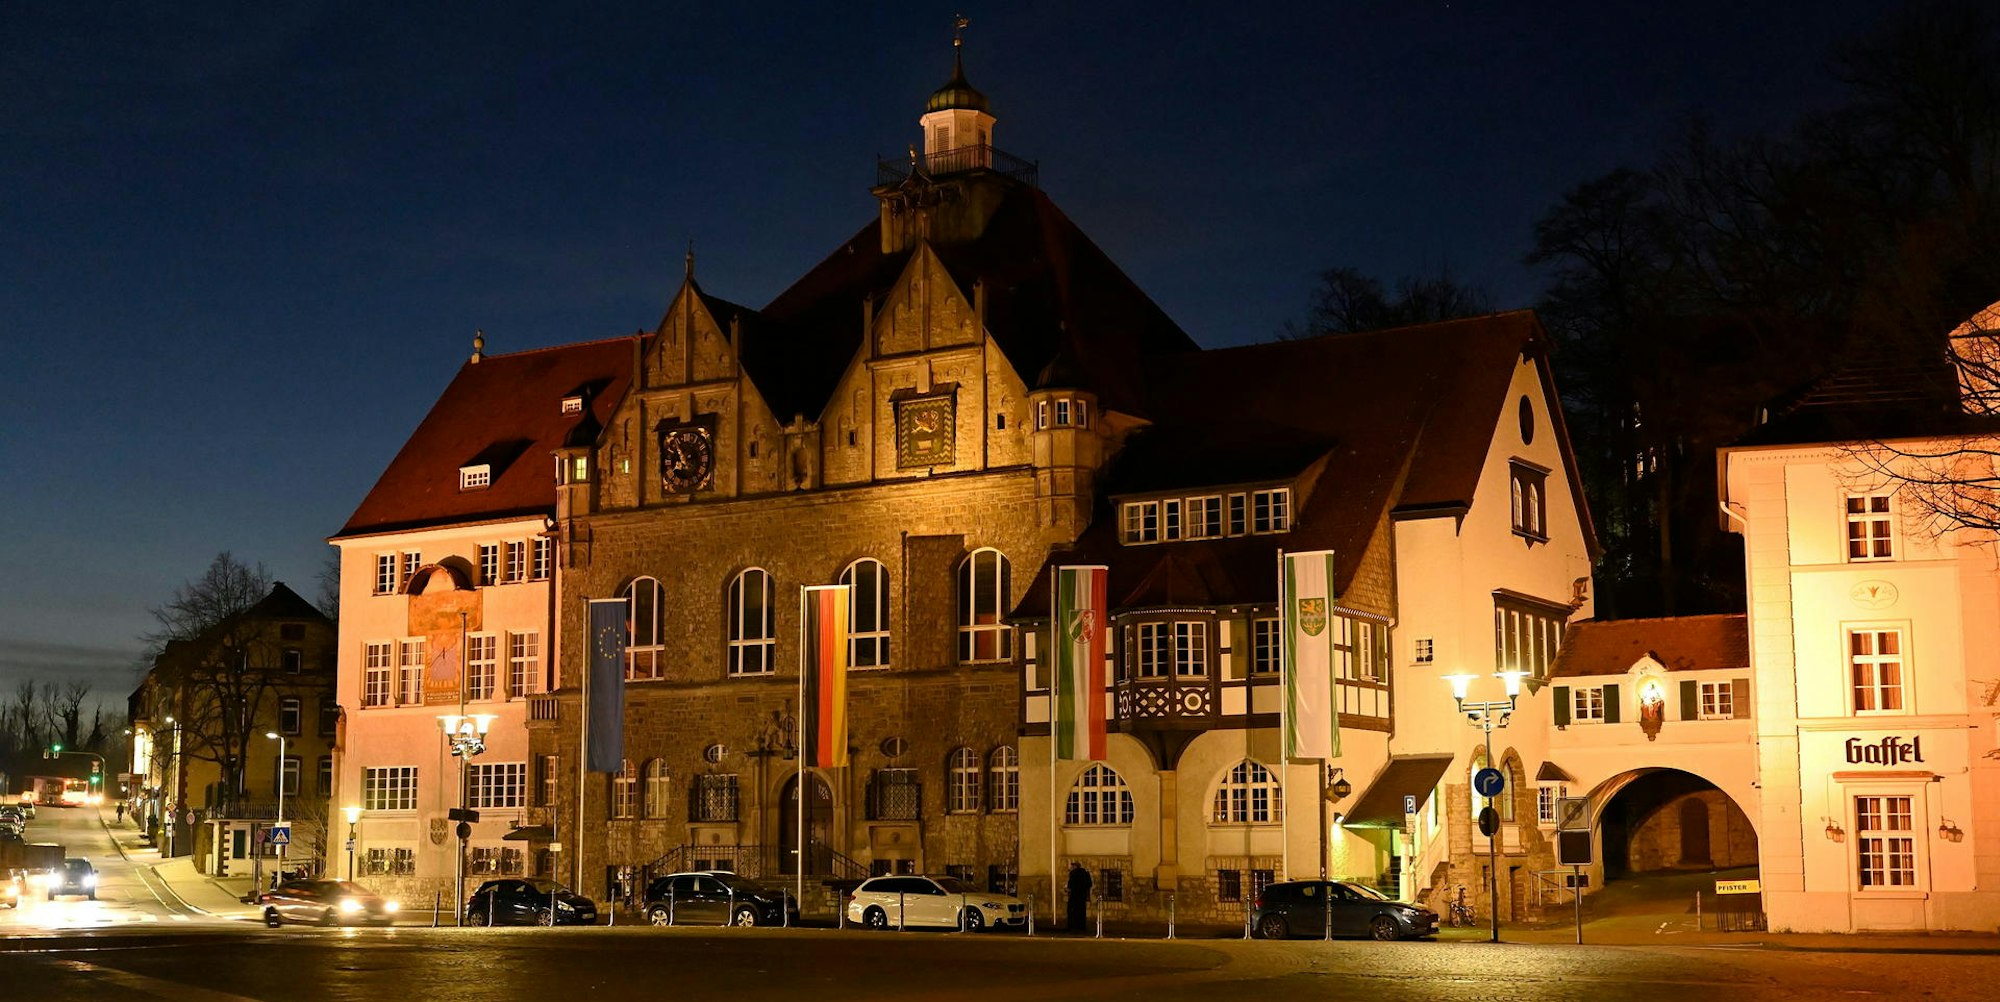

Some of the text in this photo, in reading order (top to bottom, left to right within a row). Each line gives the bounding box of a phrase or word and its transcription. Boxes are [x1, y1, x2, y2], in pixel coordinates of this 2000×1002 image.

[1845, 735, 1925, 766] Gaffel
[1407, 798, 1413, 812] P
[1718, 884, 1747, 892] PFISTER
